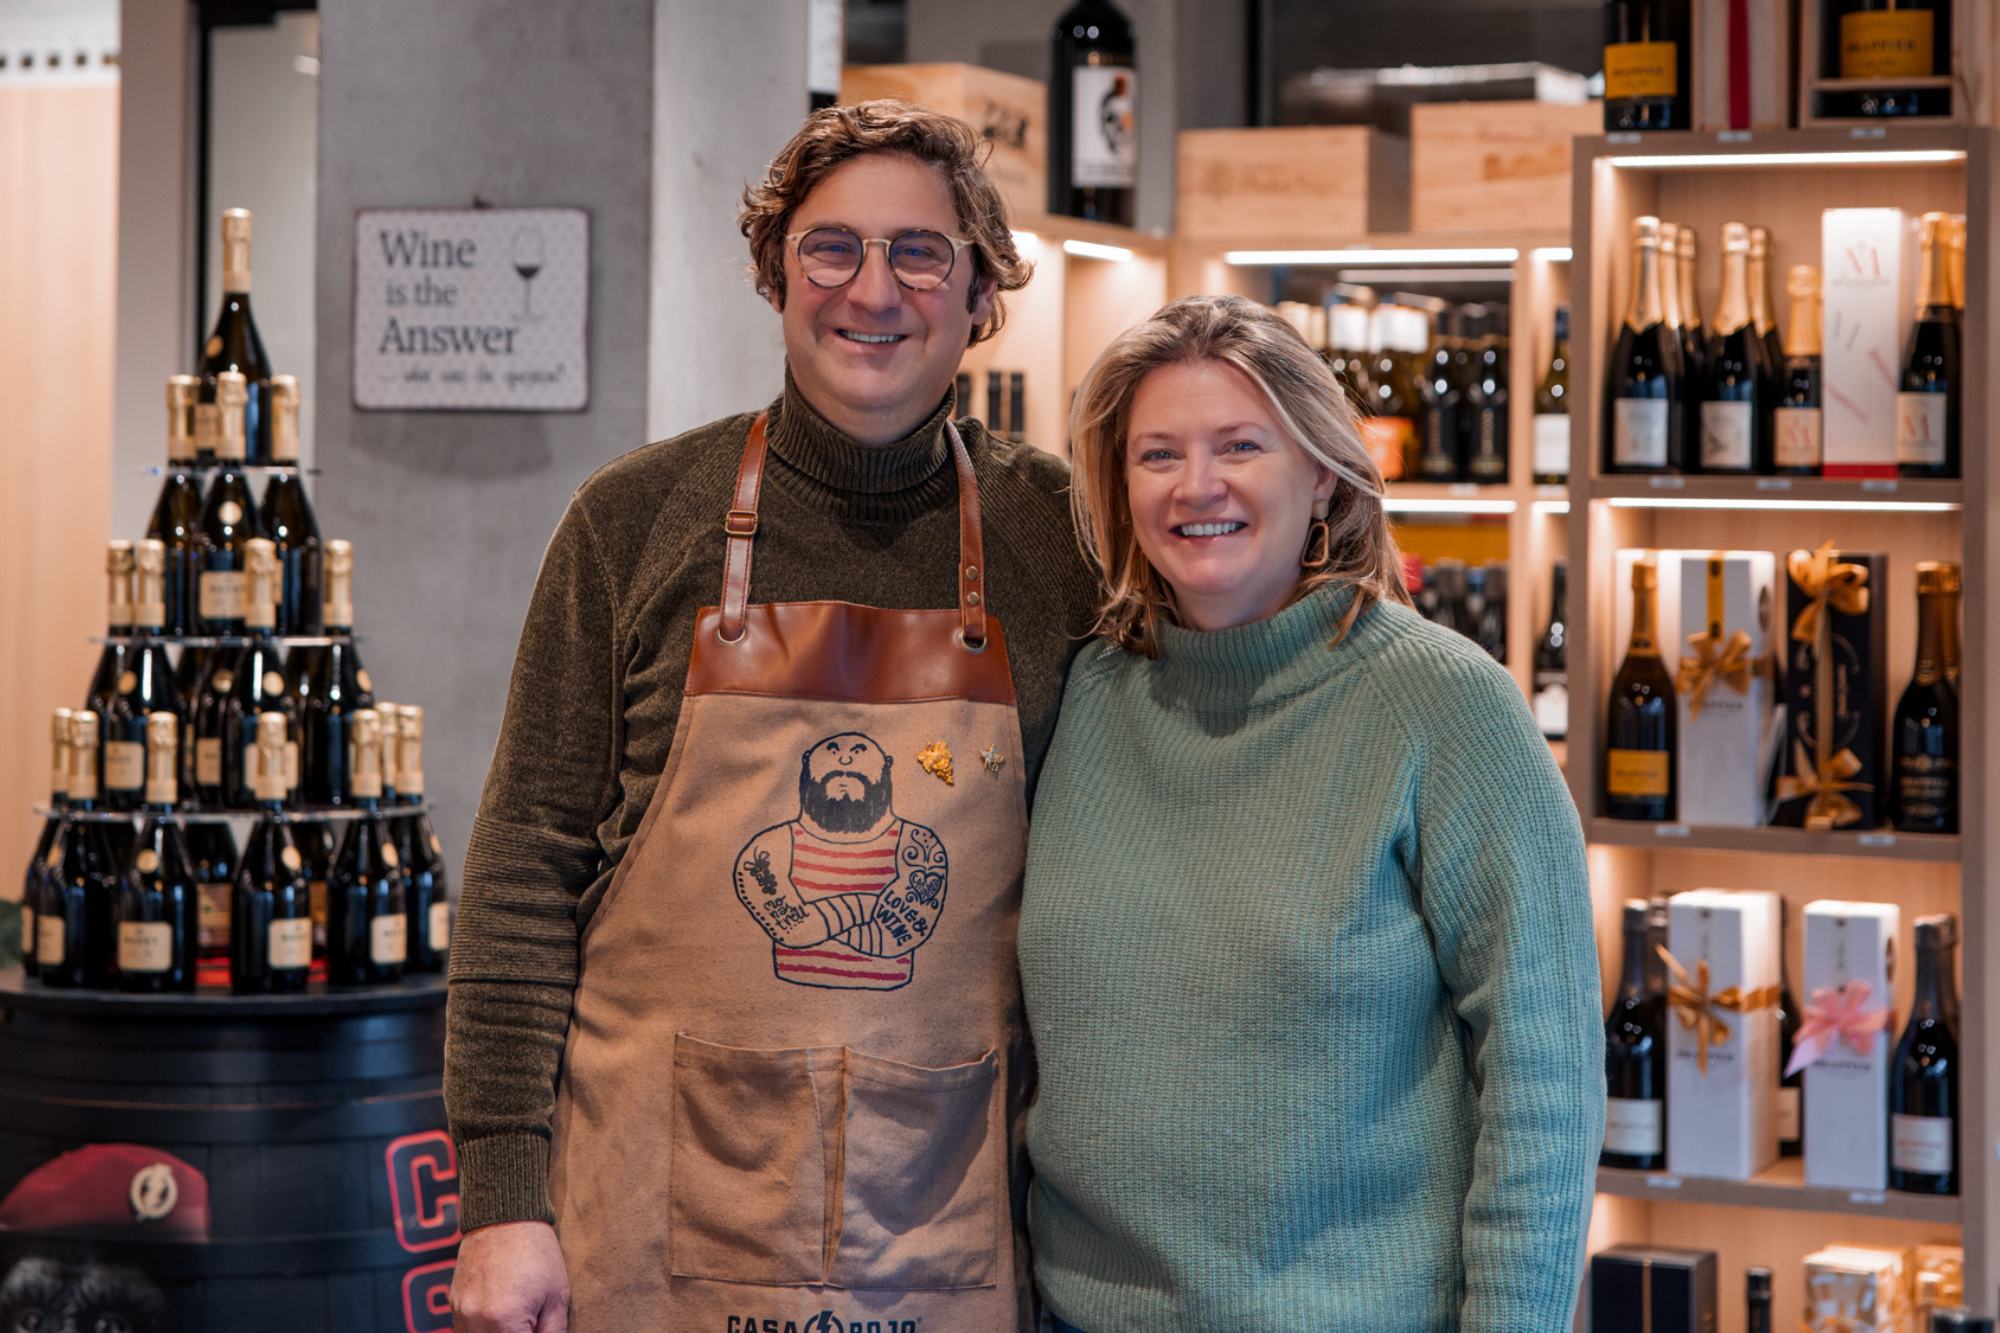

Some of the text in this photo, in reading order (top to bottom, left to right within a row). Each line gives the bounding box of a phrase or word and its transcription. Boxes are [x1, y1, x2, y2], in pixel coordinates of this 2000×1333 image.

[379, 229, 477, 269] Wine
[386, 273, 458, 307] is the
[378, 316, 520, 355] Answer
[876, 903, 913, 947] WINE
